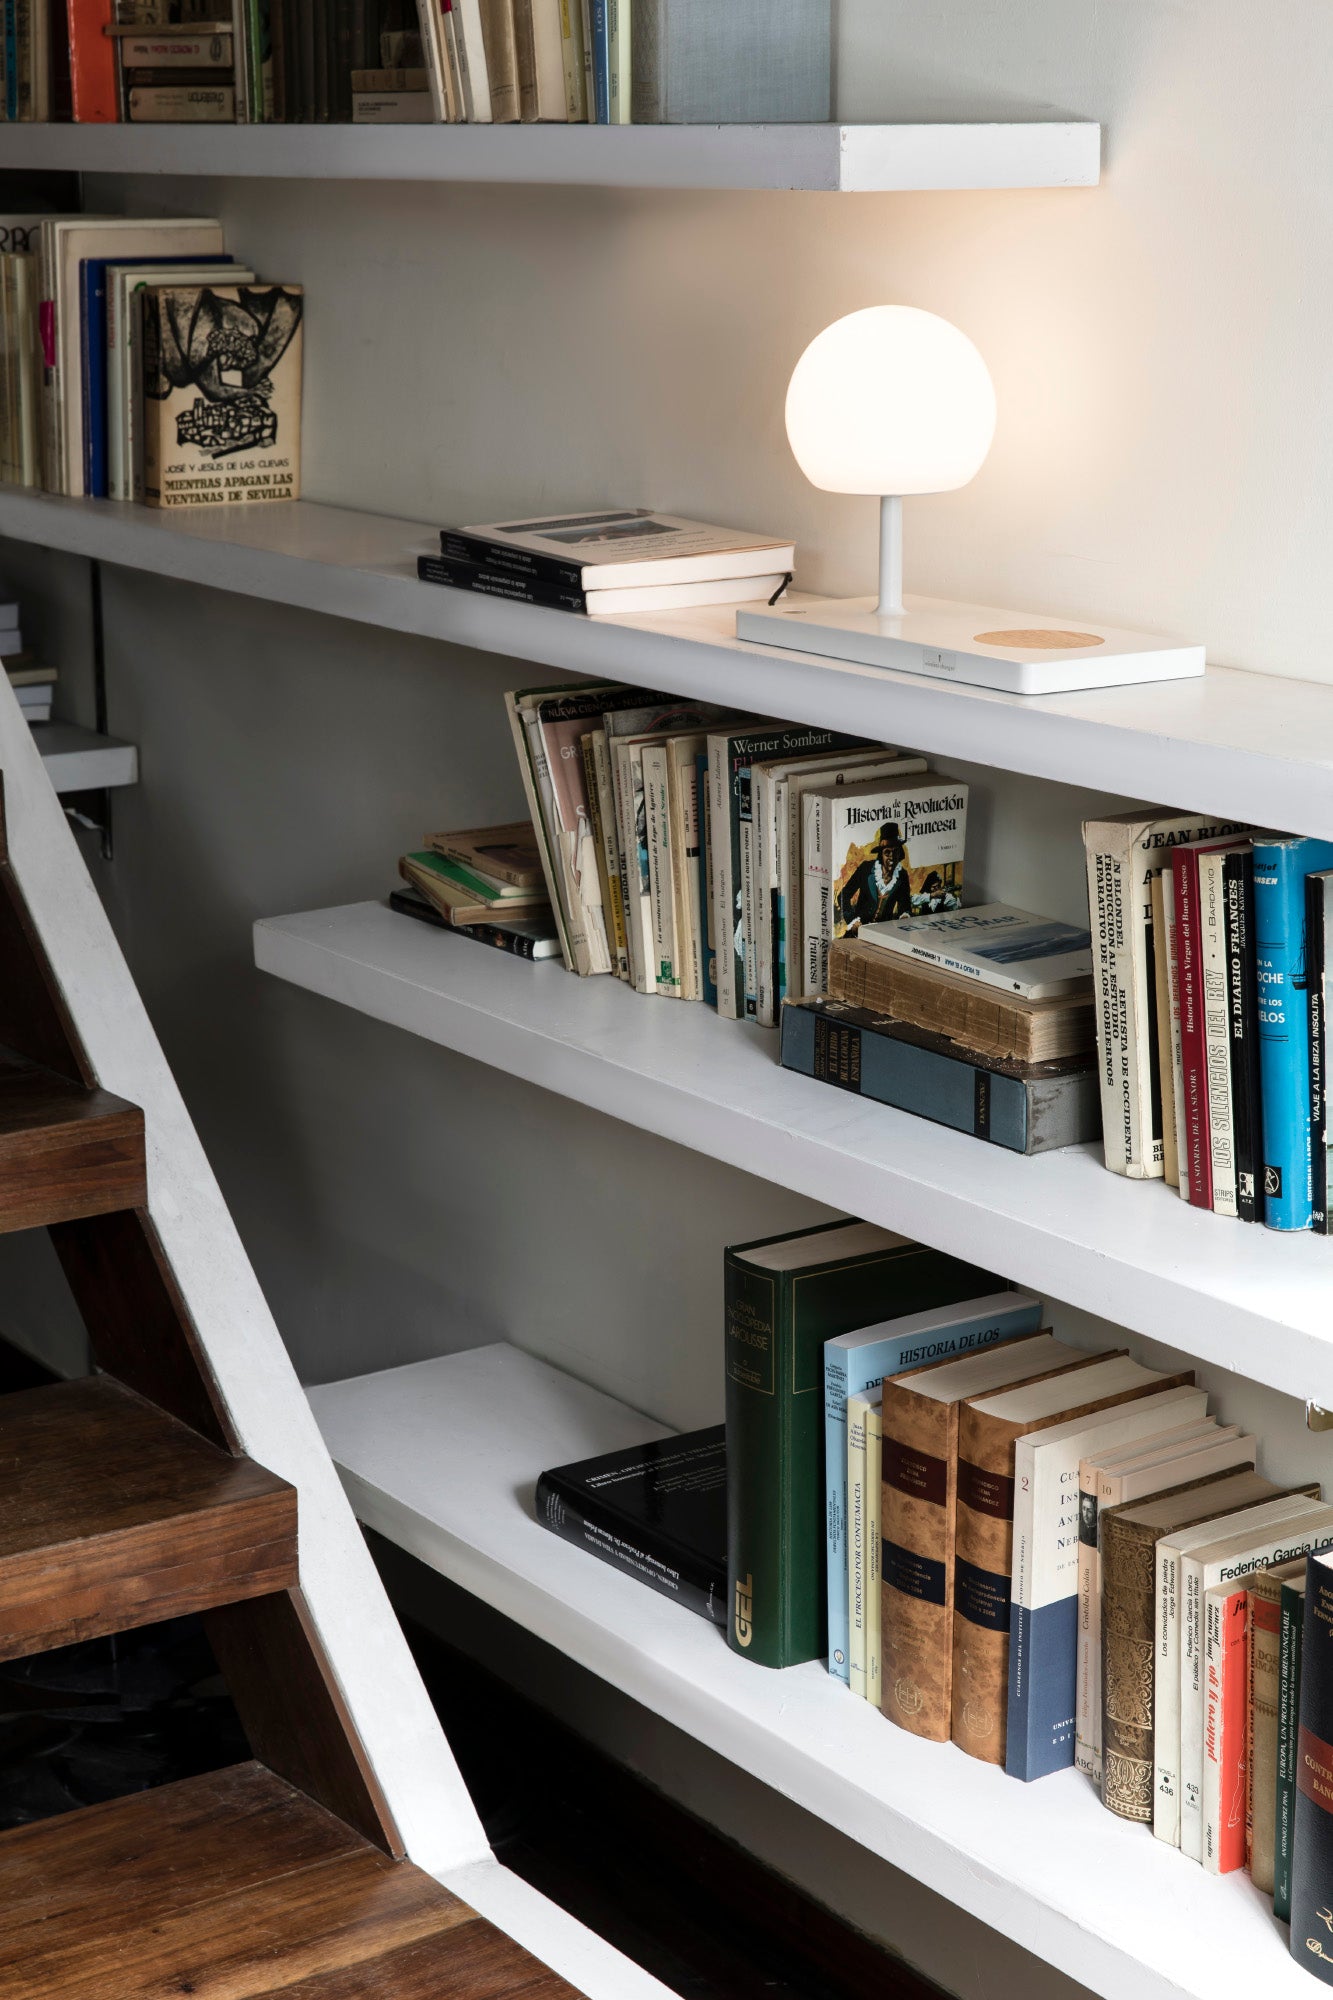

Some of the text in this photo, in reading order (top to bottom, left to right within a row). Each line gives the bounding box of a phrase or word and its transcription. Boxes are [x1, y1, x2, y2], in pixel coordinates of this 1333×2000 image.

[165, 463, 186, 474] JOSÉ
[227, 461, 236, 470] DE
[240, 460, 255, 470] LAS
[258, 458, 289, 469] CUEVAS
[165, 473, 294, 491] MIENTRAS APAGAN LAS
[165, 487, 292, 506] VENTANAS DE SEVILLA
[733, 730, 833, 755] Werner Sombart
[648, 782, 656, 811] Aguirre
[815, 809, 820, 817] DE
[844, 794, 964, 829] Historia de la Revolución
[900, 818, 957, 845] Francesa
[1141, 829, 1192, 850] JEAN
[620, 852, 631, 917] LA BODA DEL
[820, 886, 829, 927] Historia
[1113, 878, 1124, 949] BLONDEL
[1182, 897, 1190, 921] Buen
[1237, 879, 1247, 949] JACQUES KAYSER
[897, 924, 924, 932] EL
[923, 915, 980, 928] VIEJO
[948, 923, 973, 931] EL
[972, 915, 1020, 927] MAR
[808, 935, 819, 984] Francesa
[1183, 941, 1192, 970] Virgen
[1228, 879, 1243, 1040] EL DIARIO FRANCES
[963, 965, 976, 975] VIEJO
[975, 969, 981, 977] EL
[1169, 924, 1181, 1020] LOS DERECHOS HUMANOS
[1184, 972, 1192, 982] la
[1257, 973, 1284, 984] OCHE
[1108, 951, 1119, 1039] AL ESTUDIO
[1185, 984, 1193, 995] de
[1101, 943, 1114, 1087] DE LOS GOBIERNOS
[1186, 998, 1194, 1033] Historia
[1268, 999, 1283, 1007] LOS
[1206, 868, 1232, 1169] LOS SILENCIOS DEL REY J. BARDAVIO
[829, 1031, 838, 1074] EL LIBRO
[850, 1037, 859, 1082] ESPAÑOLA
[1310, 993, 1320, 1122] VIAJE A LA IBIZA INSOLITA
[1118, 988, 1133, 1165] REVISTA DE OCCIDENTE
[1191, 1108, 1202, 1192] LA SONRISA DE LA
[1214, 1188, 1234, 1199] STRIPS
[728, 1321, 769, 1351] LAROUSSE
[899, 1327, 1000, 1365] HISTORIA DE LOS
[852, 1422, 863, 1430] Juan
[1021, 1475, 1029, 1492] 2
[1085, 1474, 1091, 1485] 7
[1101, 1484, 1112, 1496] 10
[854, 1482, 862, 1552] CONTUMACIA
[621, 1541, 680, 1580] Libro Profesor
[854, 1553, 862, 1571] POR
[1220, 1542, 1311, 1583] Federico García
[1082, 1567, 1090, 1593] Colón
[1162, 1588, 1168, 1596] de
[735, 1573, 753, 1647] GEL
[855, 1615, 862, 1629] EL
[1206, 1637, 1214, 1662] juan
[1192, 1682, 1199, 1692] El
[1279, 1610, 1290, 1779] EUROPA, UN PROYECTO IRRENUNCIABLE
[1081, 1698, 1089, 1719] Felipe
[1205, 1664, 1219, 1763] platero y yo
[1075, 1756, 1092, 1772] ABC
[1156, 1767, 1176, 1779] NOVELA
[1304, 1754, 1333, 1782] CONTR
[1159, 1785, 1174, 1797] 436
[1186, 1782, 1199, 1795] 433
